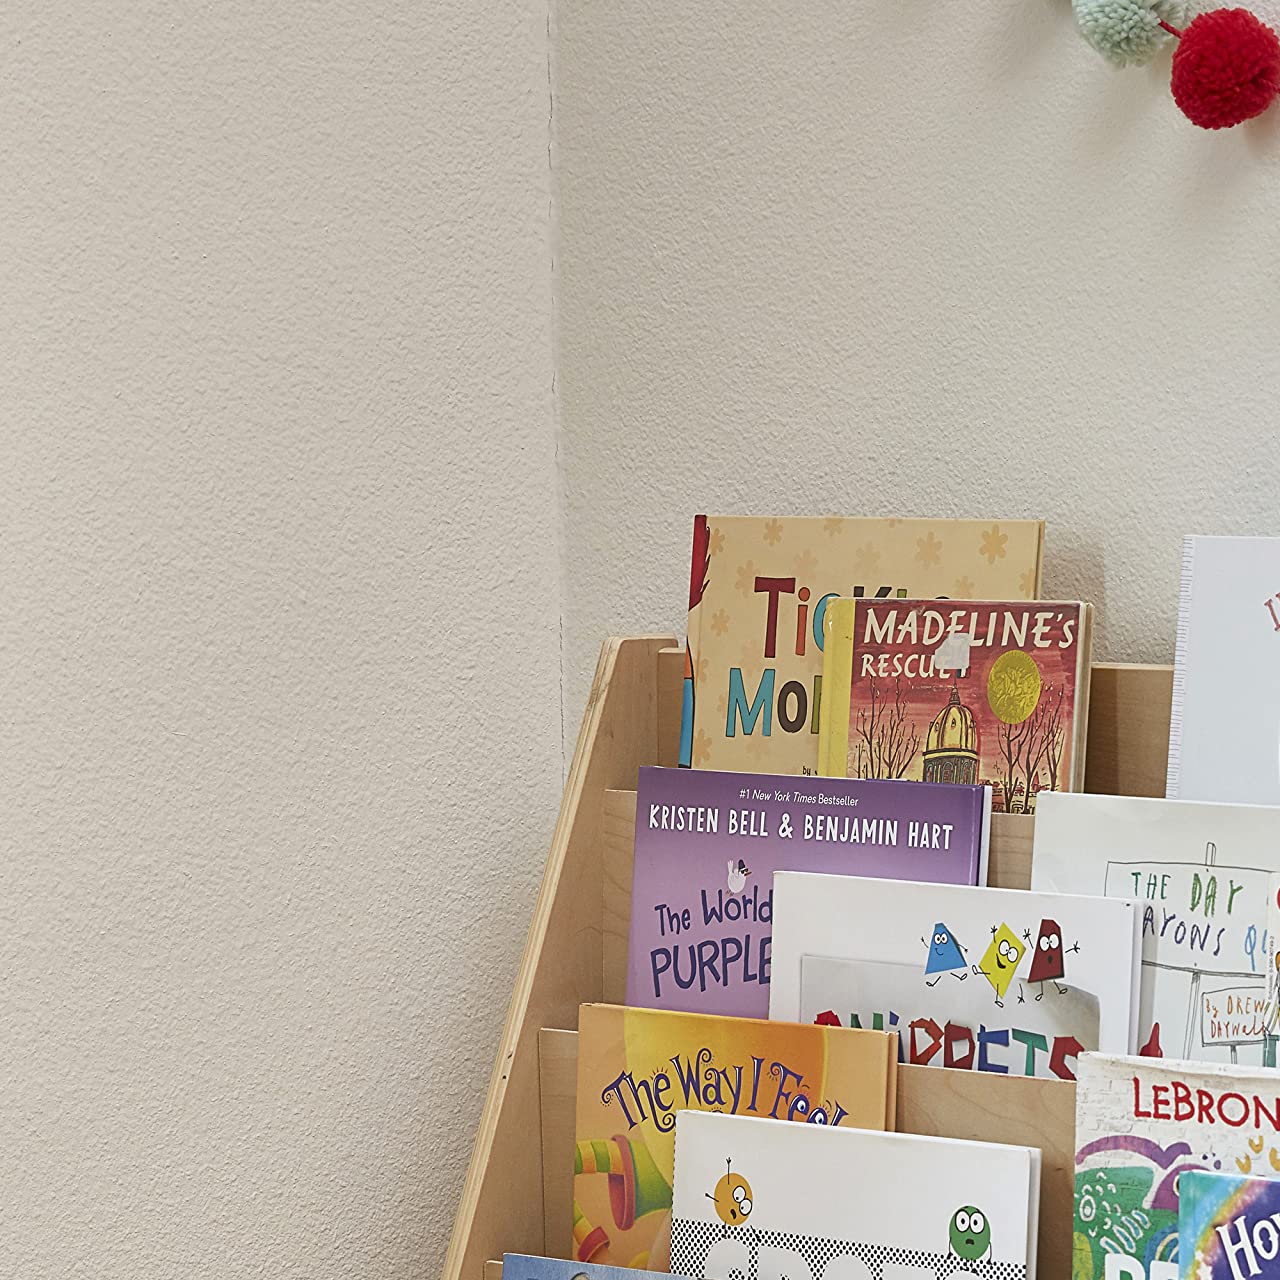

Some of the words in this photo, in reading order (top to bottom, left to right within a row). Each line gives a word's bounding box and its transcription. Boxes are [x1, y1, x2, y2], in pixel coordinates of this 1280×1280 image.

[863, 607, 1076, 649] MADELINE'S
[860, 653, 952, 679] RESCU
[725, 667, 823, 738] Mo
[739, 788, 750, 799] #1
[752, 789, 771, 801] New
[774, 791, 790, 802] York
[793, 791, 817, 804] Times
[818, 793, 859, 807] Bestseller
[649, 804, 719, 834] KRISTEN
[728, 811, 769, 838] BELL
[778, 813, 794, 839] &
[803, 814, 899, 847] BENJAMIN
[907, 822, 954, 851] HART
[654, 903, 691, 937] The
[700, 885, 774, 927] World
[1131, 871, 1171, 900] THE
[1190, 872, 1243, 917] DAY
[650, 933, 772, 999] PURPLE
[601, 1067, 676, 1133] The
[669, 1047, 744, 1115] Way
[746, 1055, 765, 1111] I
